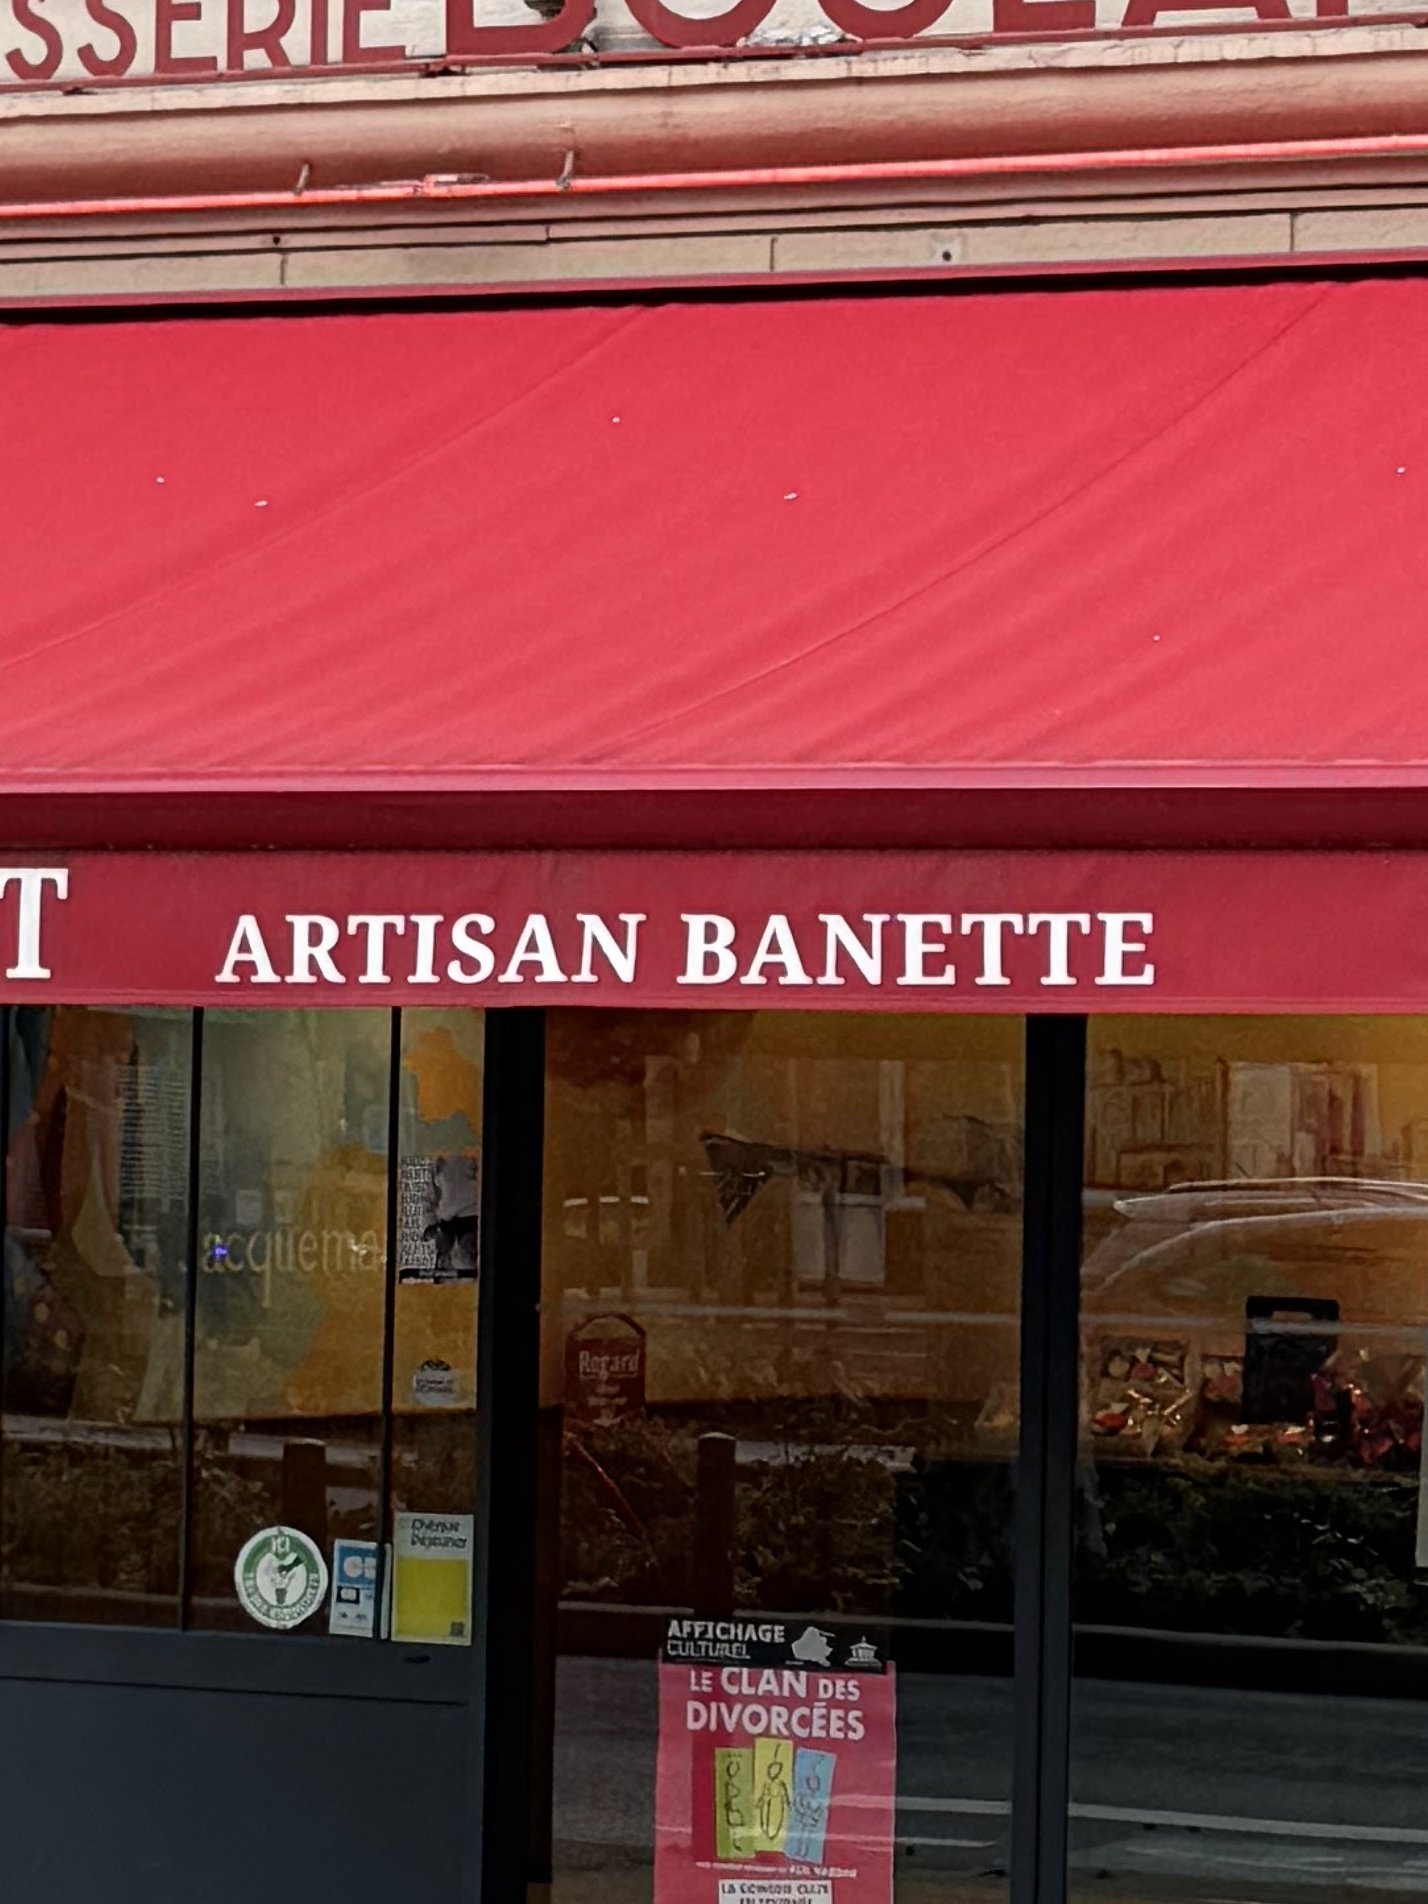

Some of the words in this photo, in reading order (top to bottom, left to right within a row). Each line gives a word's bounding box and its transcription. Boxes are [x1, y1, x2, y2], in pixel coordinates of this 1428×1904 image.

[214, 911, 647, 985] ARTISAN
[675, 910, 1156, 989] BANETTE
[666, 1639, 751, 1660] CULTUREL
[667, 1619, 786, 1644] AFFICHAGE
[689, 1667, 714, 1693] LE
[720, 1666, 808, 1698] CLAN
[817, 1678, 862, 1702] DES
[685, 1700, 866, 1741] DIVORCÉES
